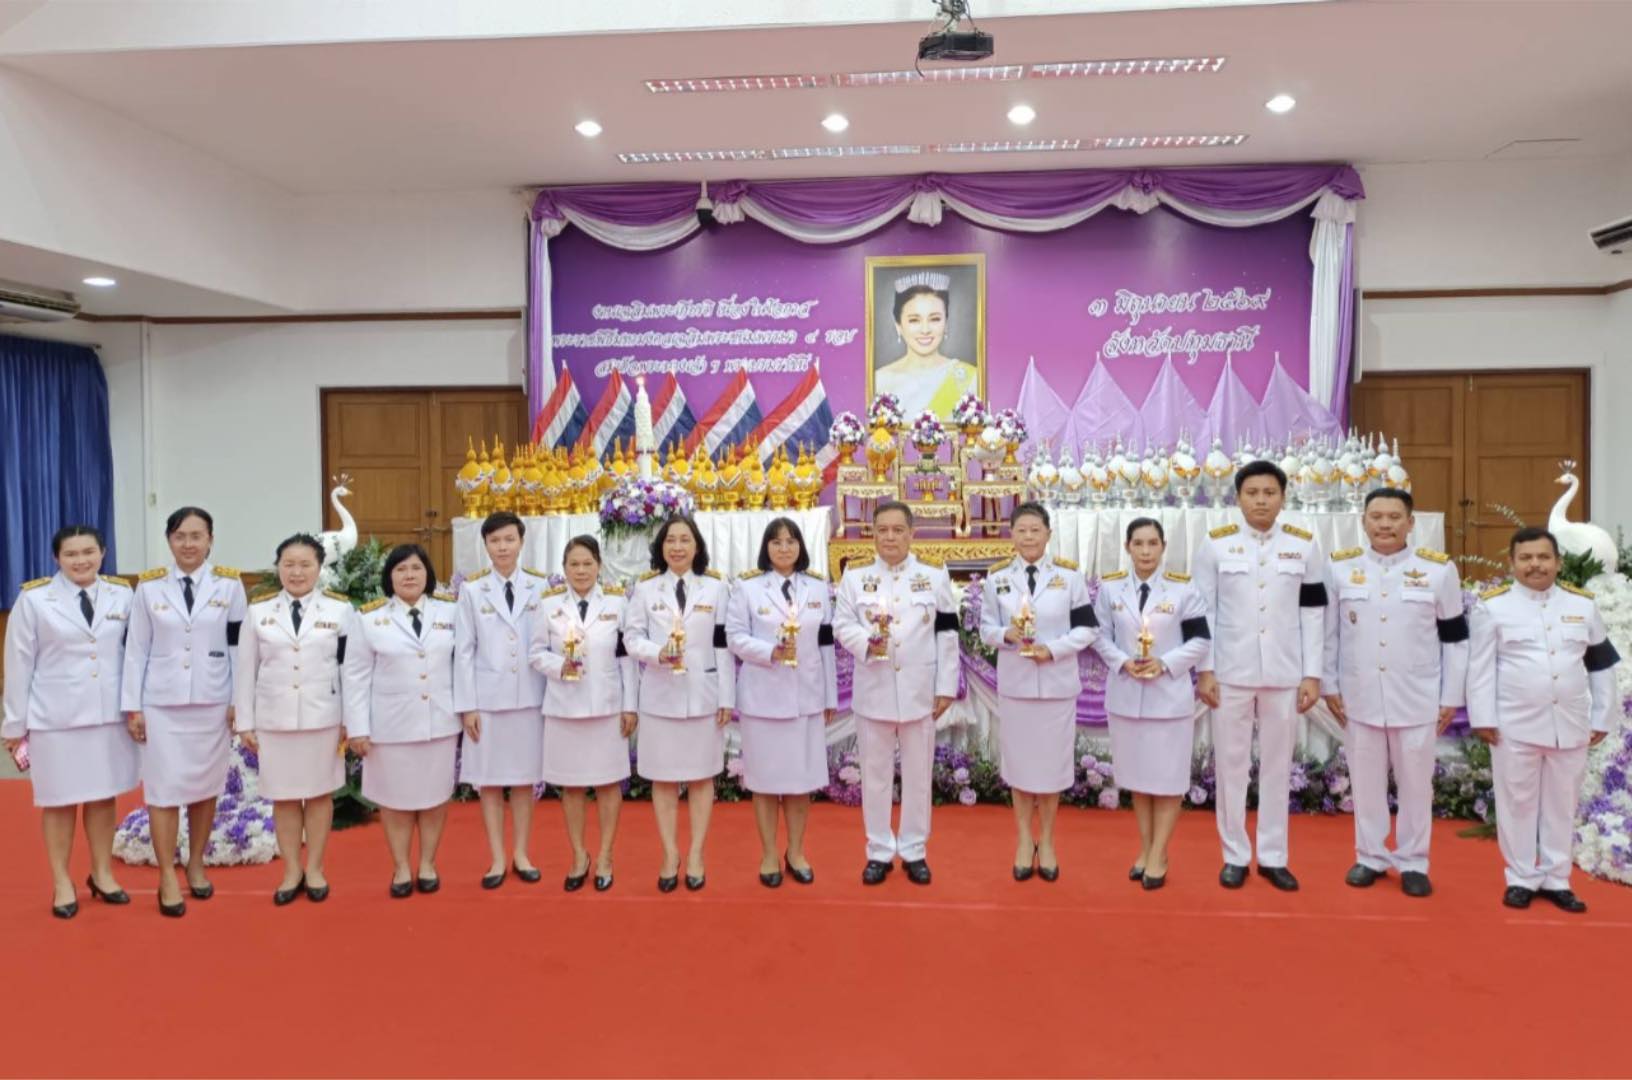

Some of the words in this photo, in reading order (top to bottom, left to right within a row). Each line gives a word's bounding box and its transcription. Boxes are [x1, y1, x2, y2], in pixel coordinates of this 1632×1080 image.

[1087, 298, 1109, 317] ๓
[1114, 288, 1202, 326] มิถุนายน
[1103, 324, 1261, 366] จังหวัดปทุมธานี
